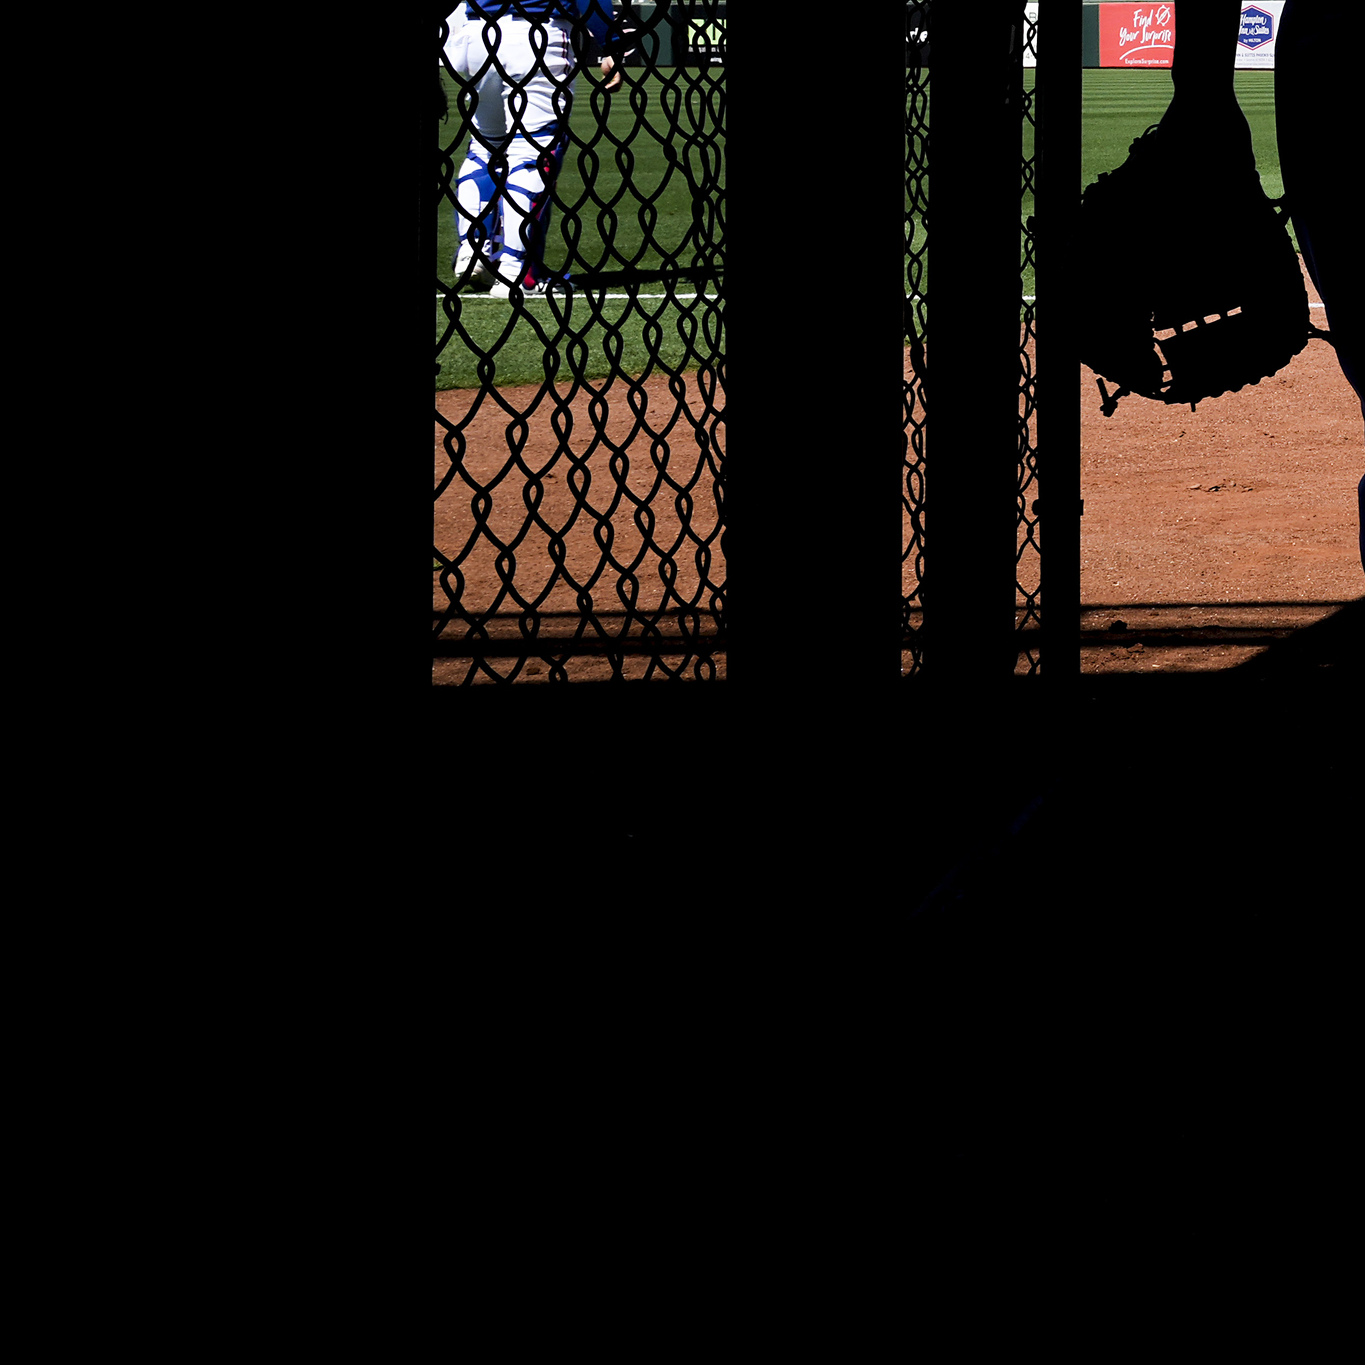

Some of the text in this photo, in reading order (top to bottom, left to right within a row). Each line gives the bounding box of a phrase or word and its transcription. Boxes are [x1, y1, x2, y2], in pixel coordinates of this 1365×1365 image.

[1133, 8, 1154, 28] Find
[1119, 24, 1172, 47] Your Surprise
